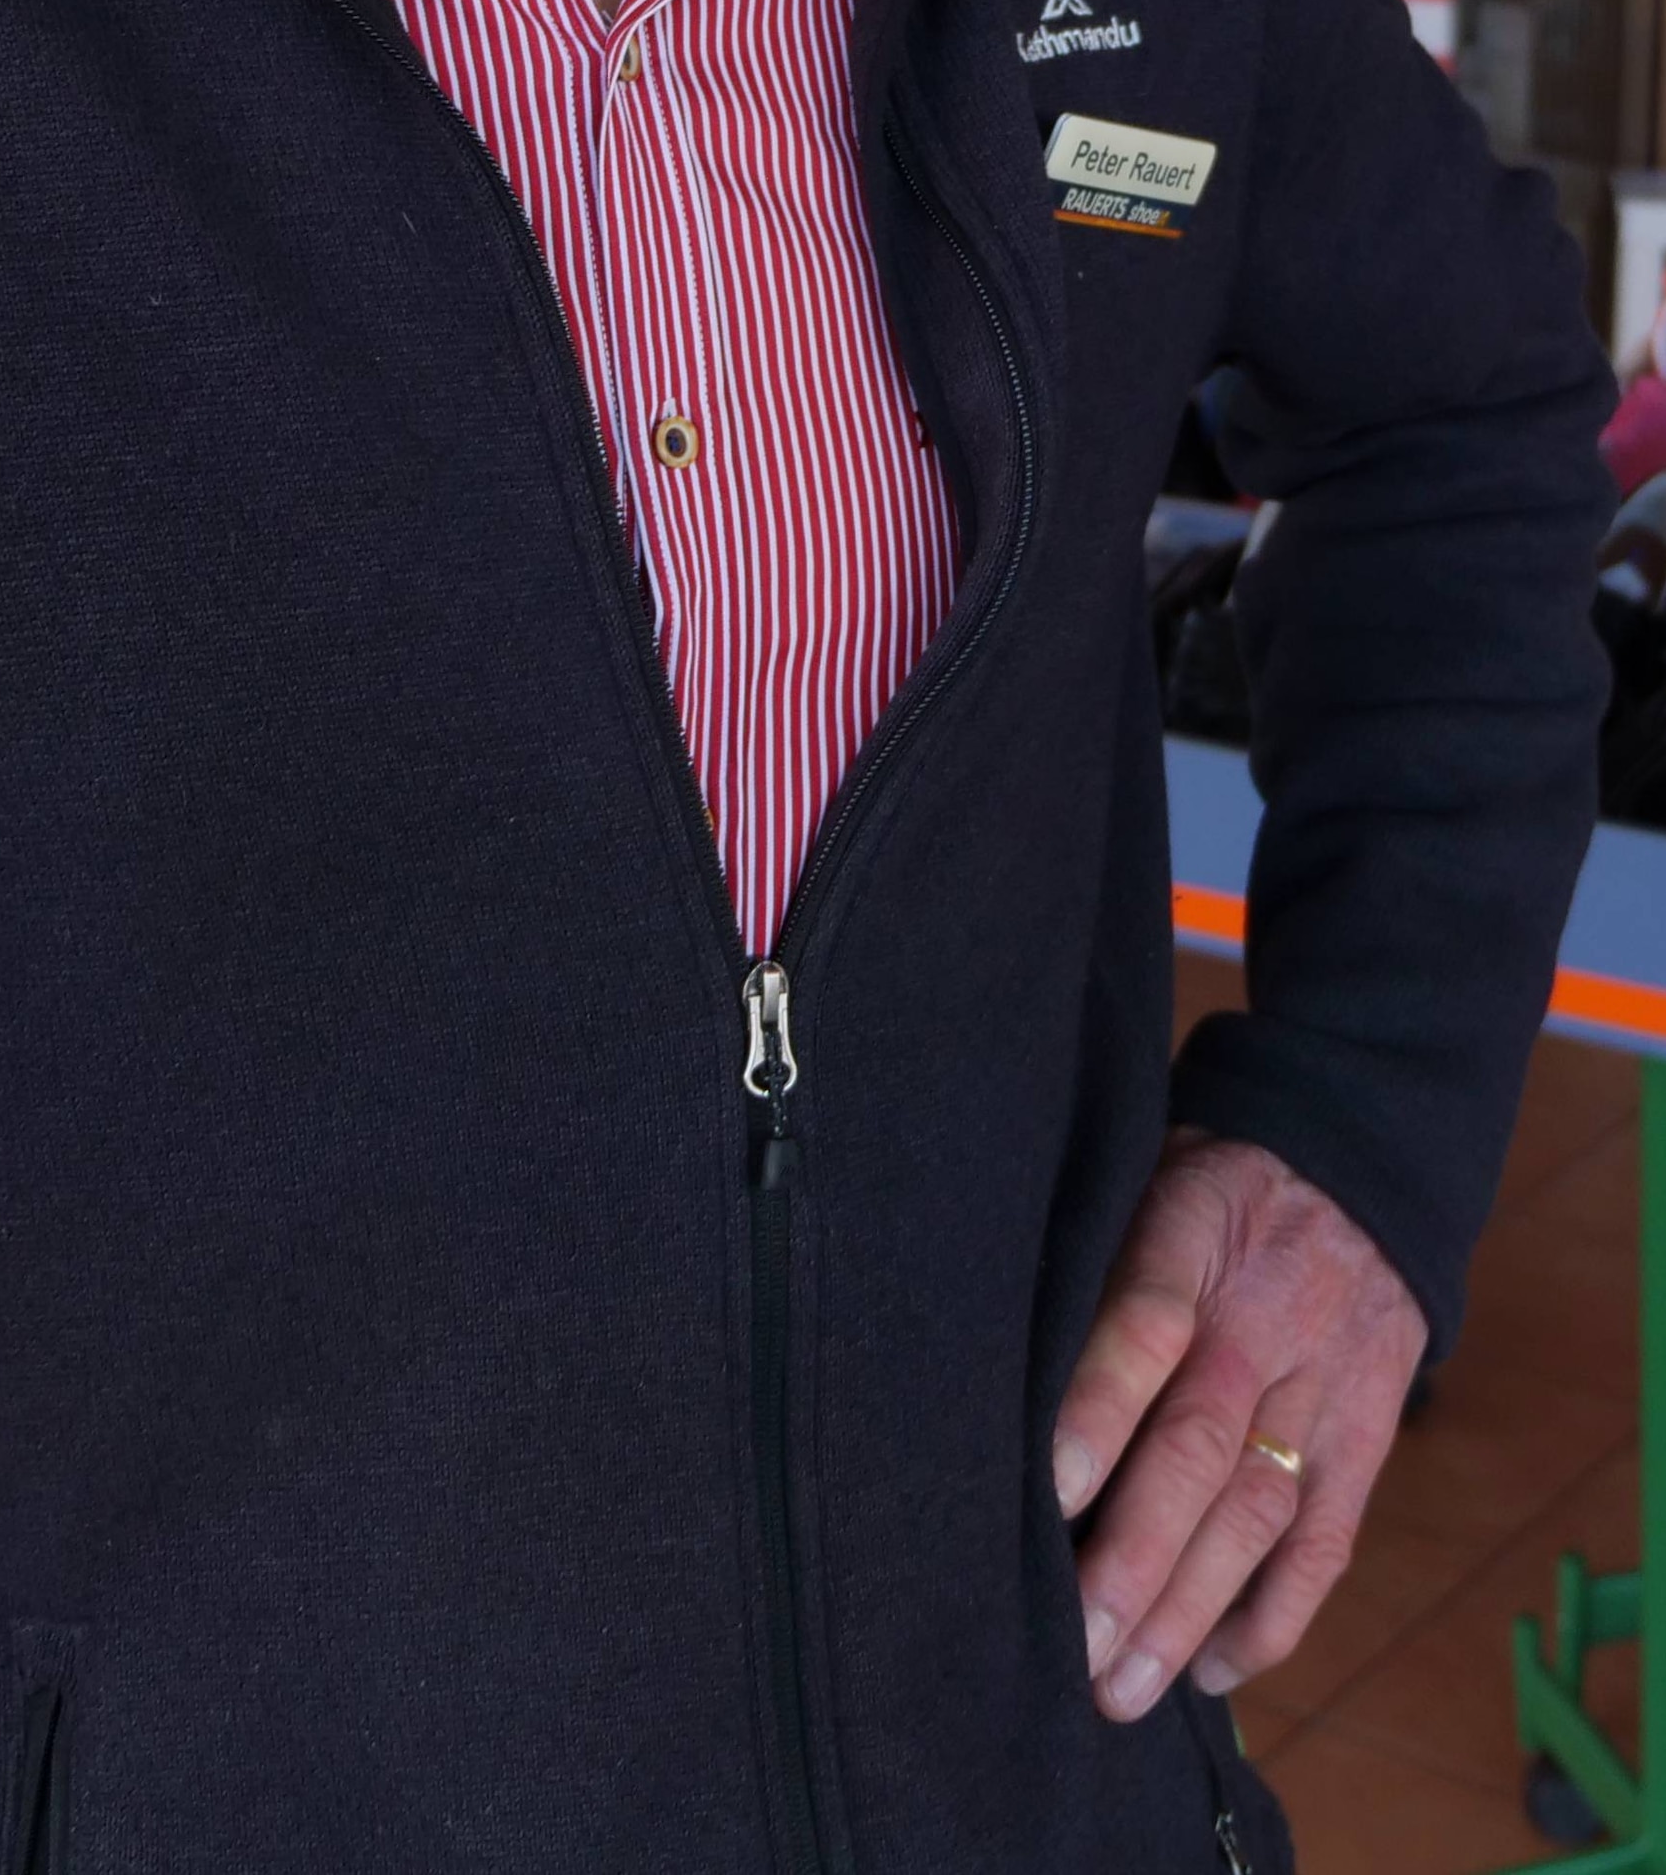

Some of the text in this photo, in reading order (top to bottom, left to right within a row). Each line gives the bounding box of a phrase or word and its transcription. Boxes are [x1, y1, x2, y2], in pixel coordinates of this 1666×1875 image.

[1071, 140, 1196, 190] Peter Rauert
[1061, 188, 1130, 219] RAUERTS
